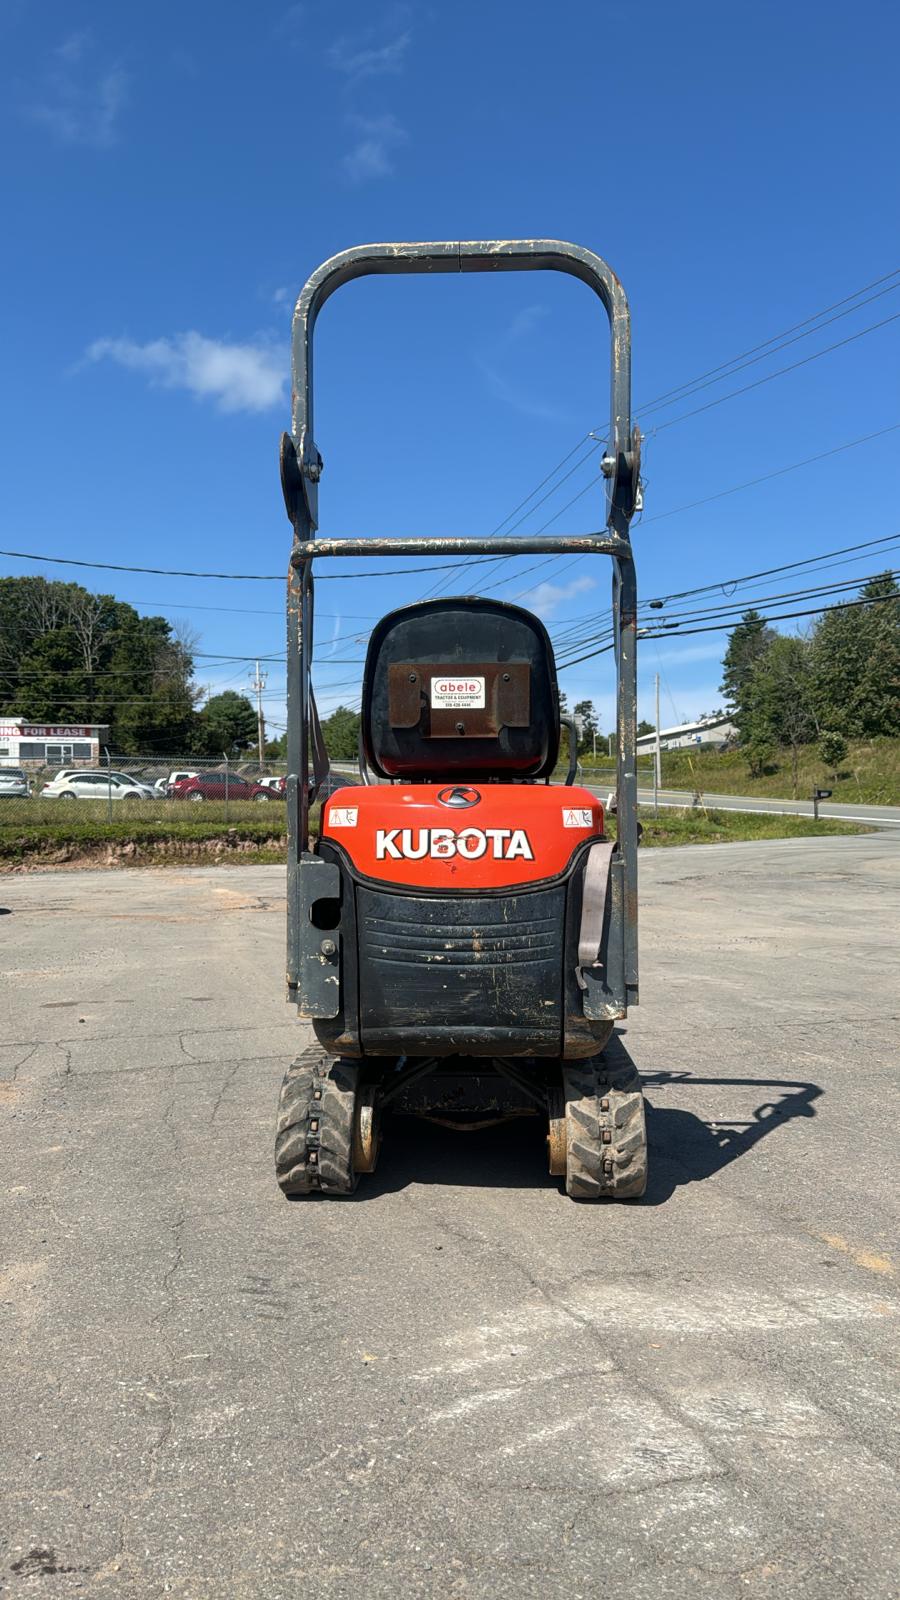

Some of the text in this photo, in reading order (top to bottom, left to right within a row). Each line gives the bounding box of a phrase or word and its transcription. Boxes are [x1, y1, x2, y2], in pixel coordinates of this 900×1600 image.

[440, 682, 476, 691] abele
[24, 727, 46, 736] FOR
[50, 727, 86, 736] LEASE
[376, 828, 534, 860] KUBOTA
